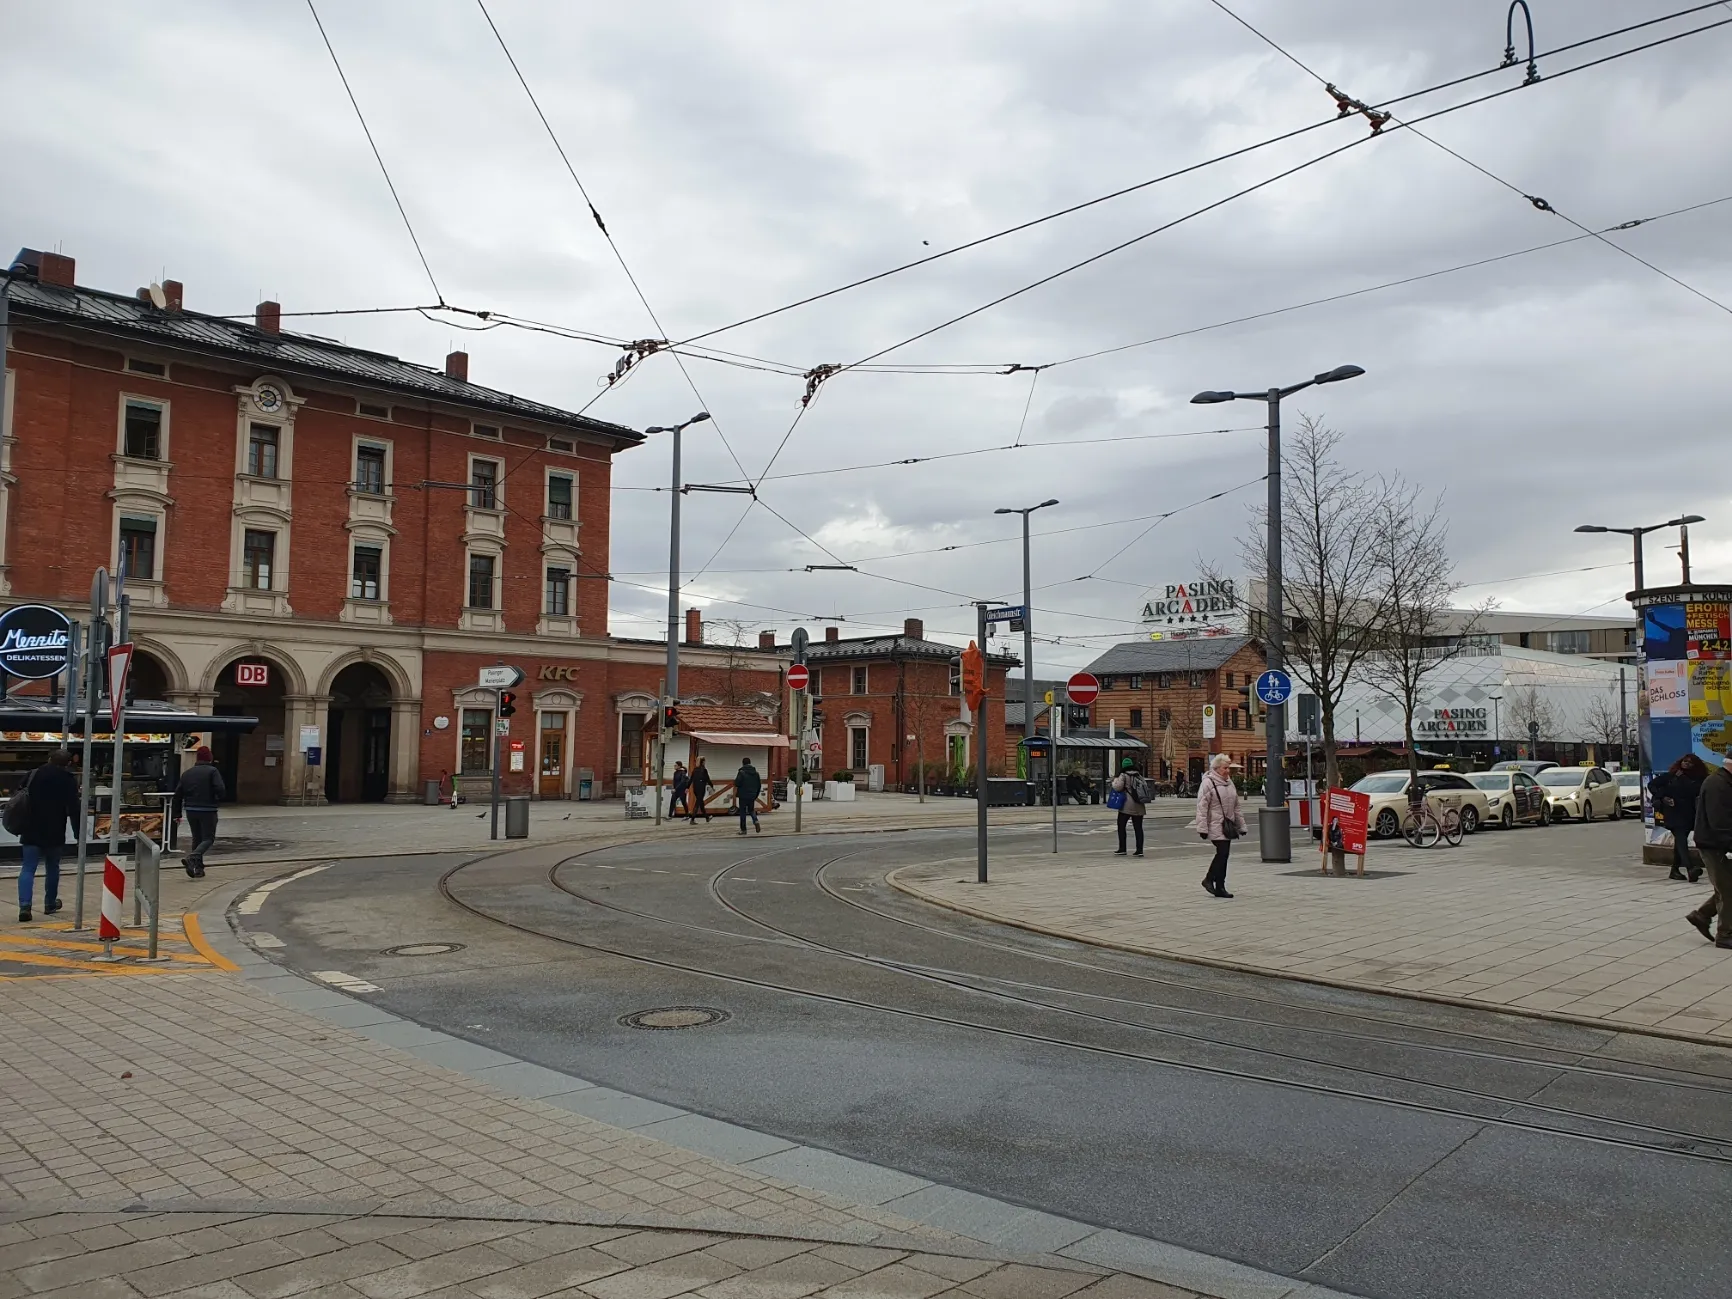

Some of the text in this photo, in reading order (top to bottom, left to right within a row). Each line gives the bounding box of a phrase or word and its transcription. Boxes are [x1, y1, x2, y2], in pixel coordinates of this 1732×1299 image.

[1165, 580, 1234, 598] PASING
[1649, 594, 1681, 603] SZENE
[1141, 597, 1234, 616] ARCADEN
[1686, 603, 1729, 612] EROTIK
[1686, 619, 1718, 628] MESSE
[0, 629, 68, 649] Mezzito
[1688, 633, 1718, 641] MÜNCHEN
[240, 666, 265, 682] DB
[537, 665, 581, 681] KFC
[1650, 686, 1663, 695] DAS
[1650, 690, 1686, 703] SCHLOSS
[1434, 708, 1487, 719] PASING
[1418, 720, 1487, 731] ARCADEN
